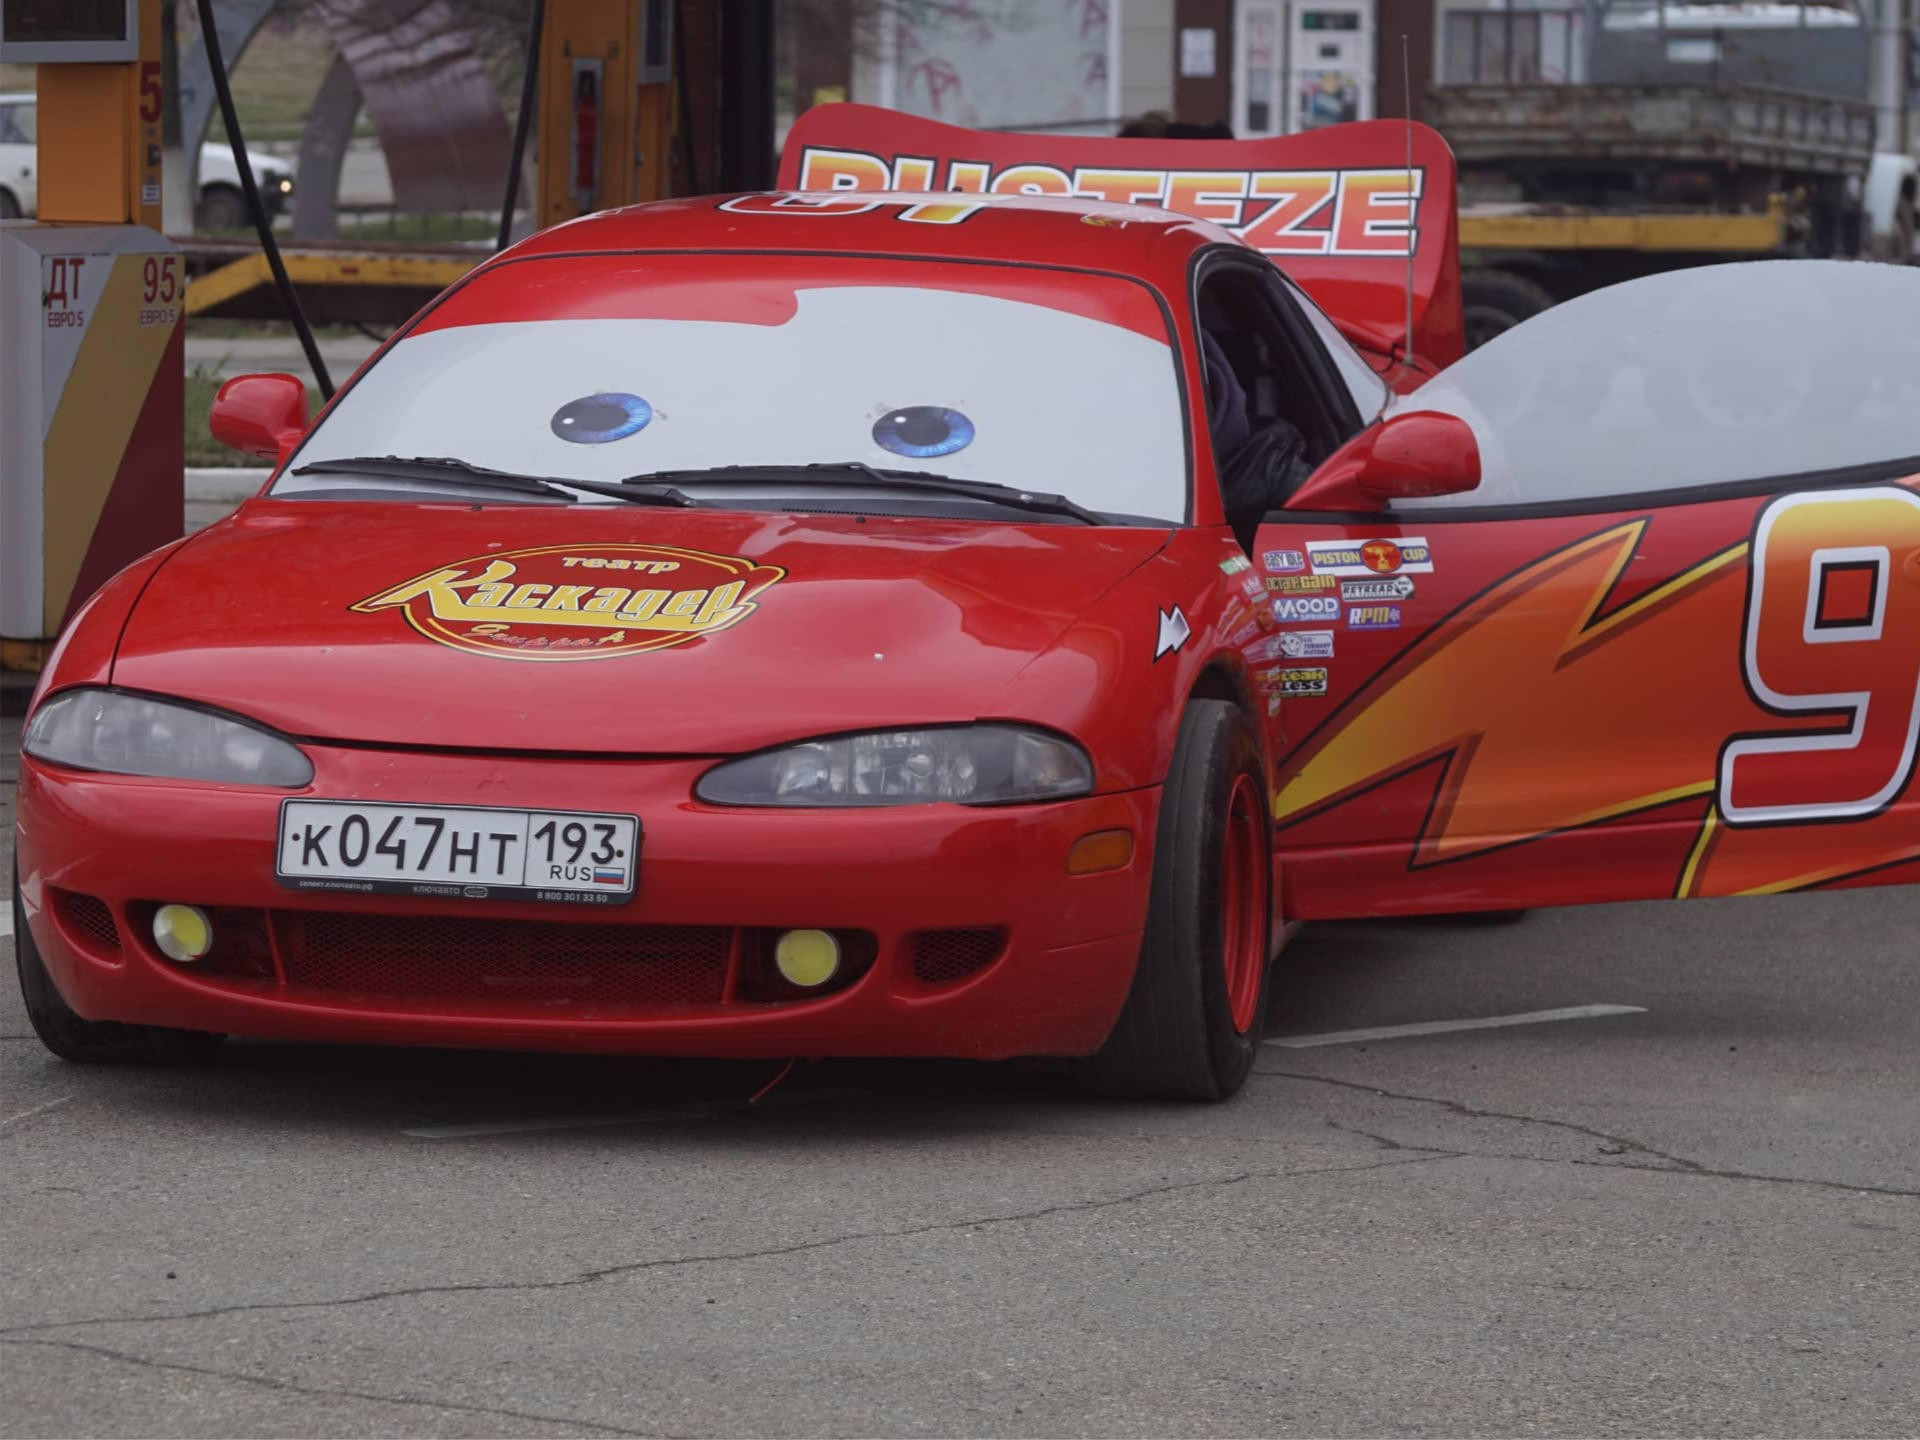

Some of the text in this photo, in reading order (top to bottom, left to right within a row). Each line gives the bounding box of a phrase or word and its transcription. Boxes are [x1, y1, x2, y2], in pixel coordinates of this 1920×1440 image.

[47, 257, 85, 309] ДТ
[143, 256, 176, 303] 95
[47, 311, 84, 328] ЕВРО 5
[140, 308, 176, 326] ЕВРО 5
[562, 556, 680, 574] театр
[1312, 546, 1428, 566] PISTON CUP
[368, 560, 746, 630] Каскадер
[1274, 597, 1338, 618] MOOD
[1349, 607, 1391, 625] RPM
[301, 814, 518, 876] К047НТ
[534, 820, 618, 865] 193
[549, 864, 592, 882] RUS
[545, 892, 562, 901] 800
[564, 893, 580, 902] 301
[583, 894, 594, 902] 33
[596, 895, 608, 903] 50
